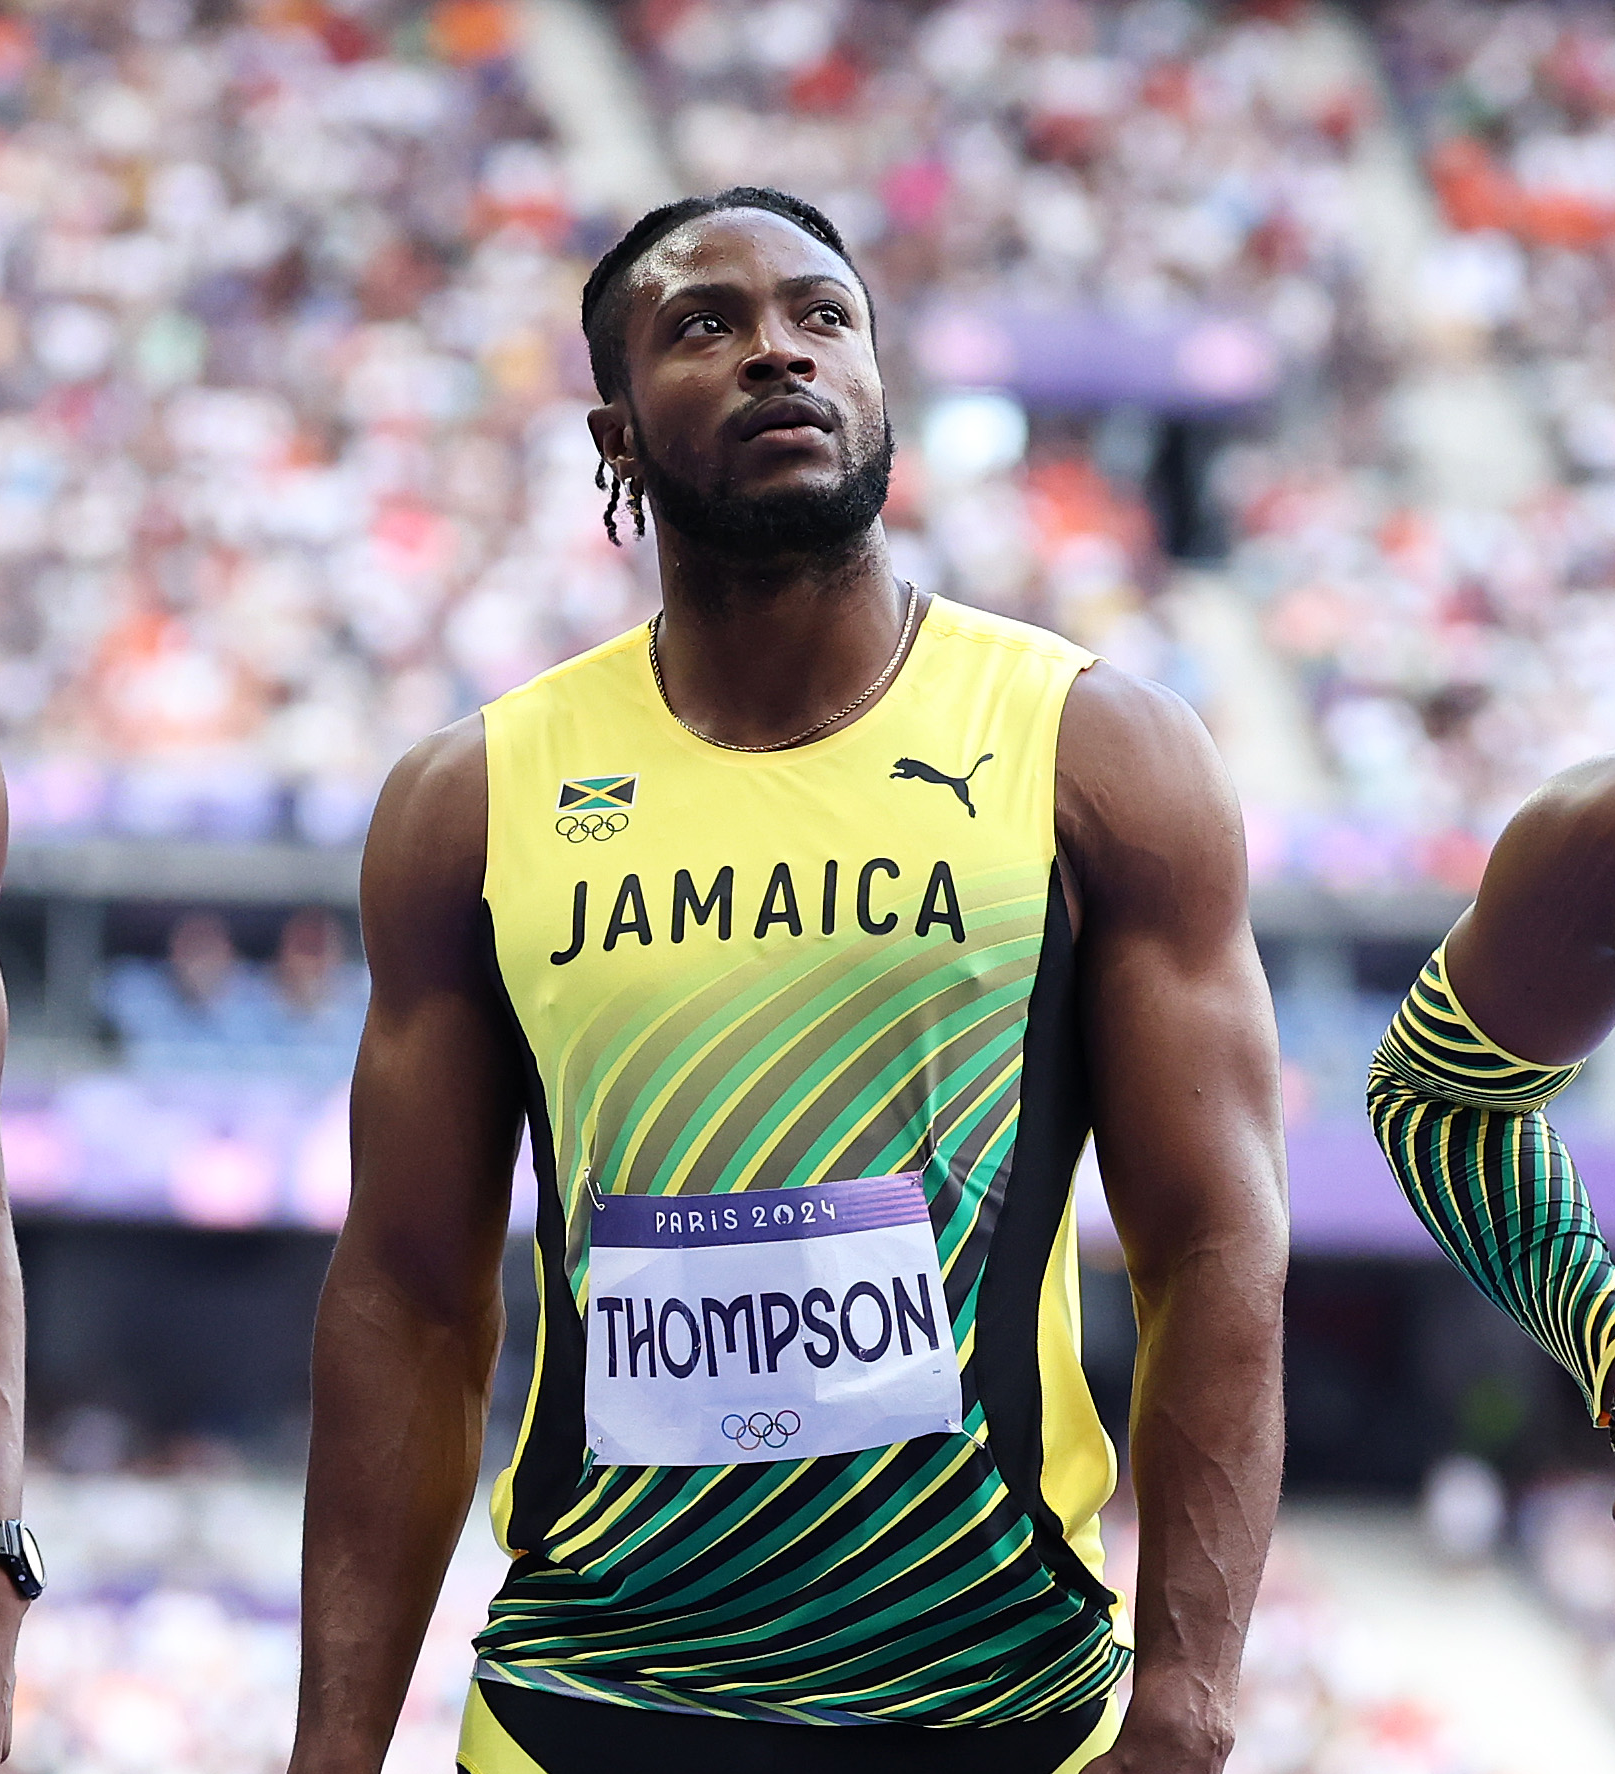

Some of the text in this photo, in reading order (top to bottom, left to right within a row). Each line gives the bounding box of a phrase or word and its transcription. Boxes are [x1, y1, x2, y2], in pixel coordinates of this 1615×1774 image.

[550, 857, 966, 966] JAMAICA
[751, 1199, 837, 1228] 2024
[596, 1272, 941, 1380] THOMPSON
